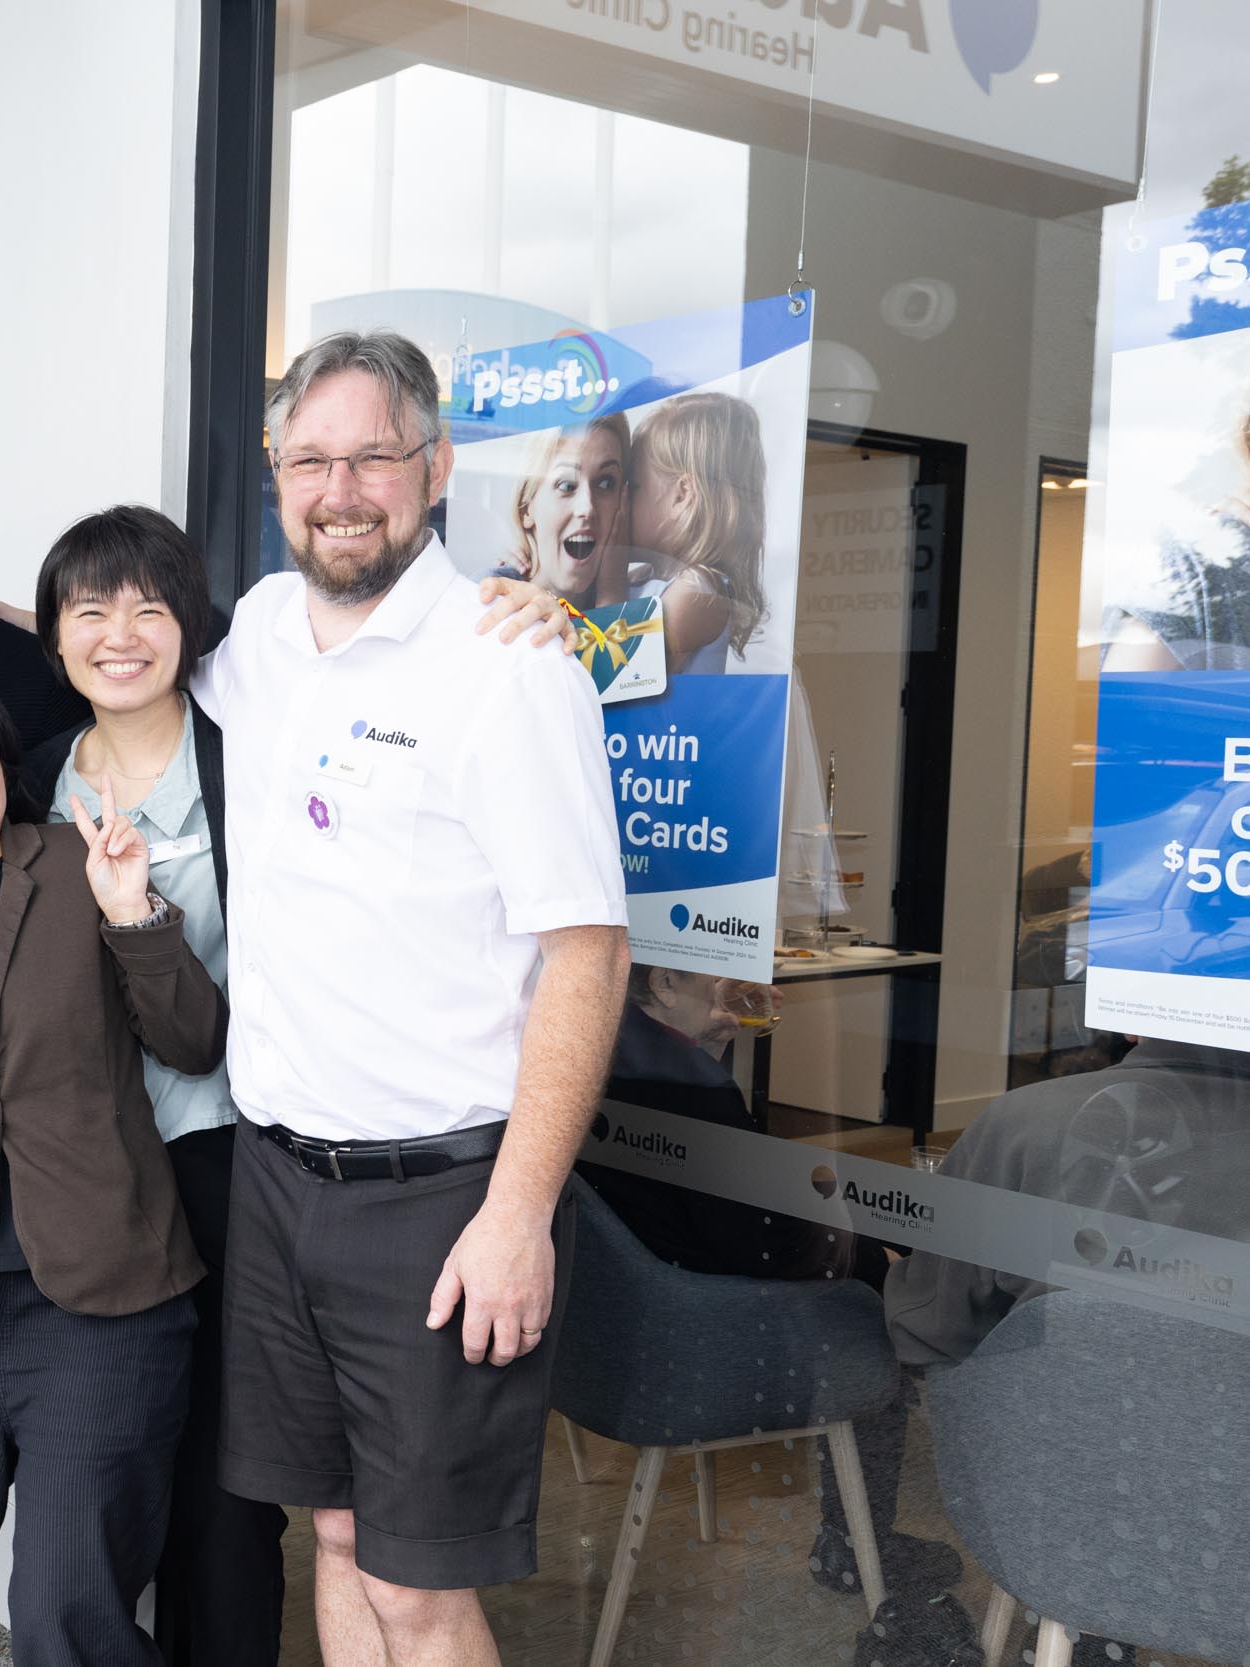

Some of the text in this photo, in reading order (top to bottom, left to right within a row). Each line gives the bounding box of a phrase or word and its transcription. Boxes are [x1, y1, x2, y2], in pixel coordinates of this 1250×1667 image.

[1157, 241, 1250, 301] Ps
[365, 727, 418, 749] Audika
[637, 724, 699, 761] win
[619, 768, 691, 805] four
[625, 811, 729, 853] Cards
[691, 913, 760, 940] Audika
[612, 1125, 687, 1160] Audika
[841, 1181, 934, 1222] Audika
[871, 1210, 906, 1228] Hearing
[1112, 1246, 1234, 1296] Audika
